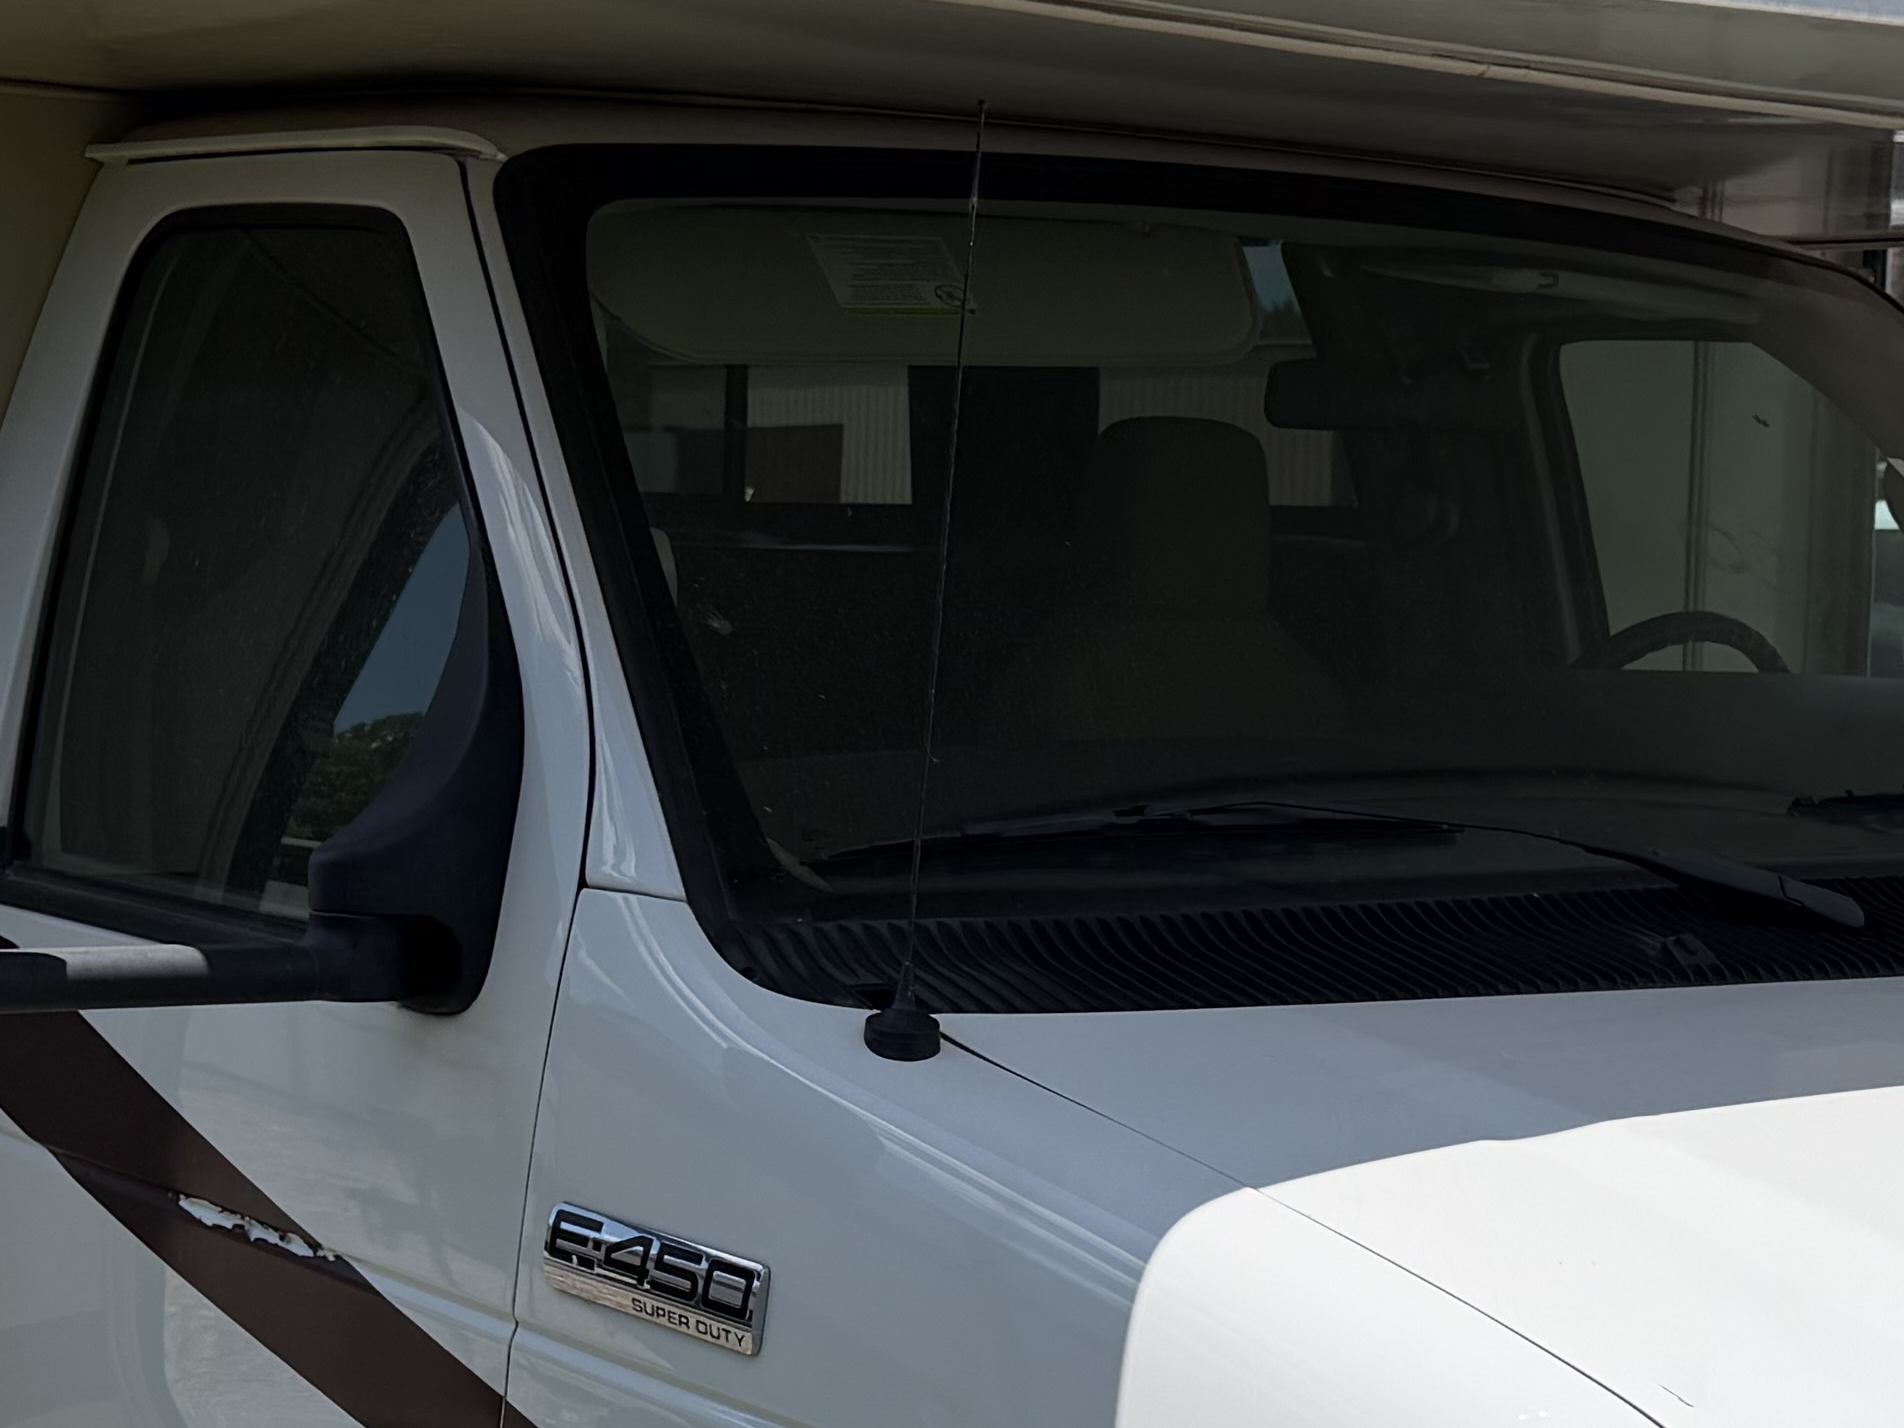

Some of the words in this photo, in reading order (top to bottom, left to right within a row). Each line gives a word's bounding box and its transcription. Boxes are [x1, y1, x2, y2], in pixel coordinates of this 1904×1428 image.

[548, 1208, 757, 1323] E-450
[630, 1297, 691, 1330] SUPER
[696, 1319, 747, 1348] DUTY
